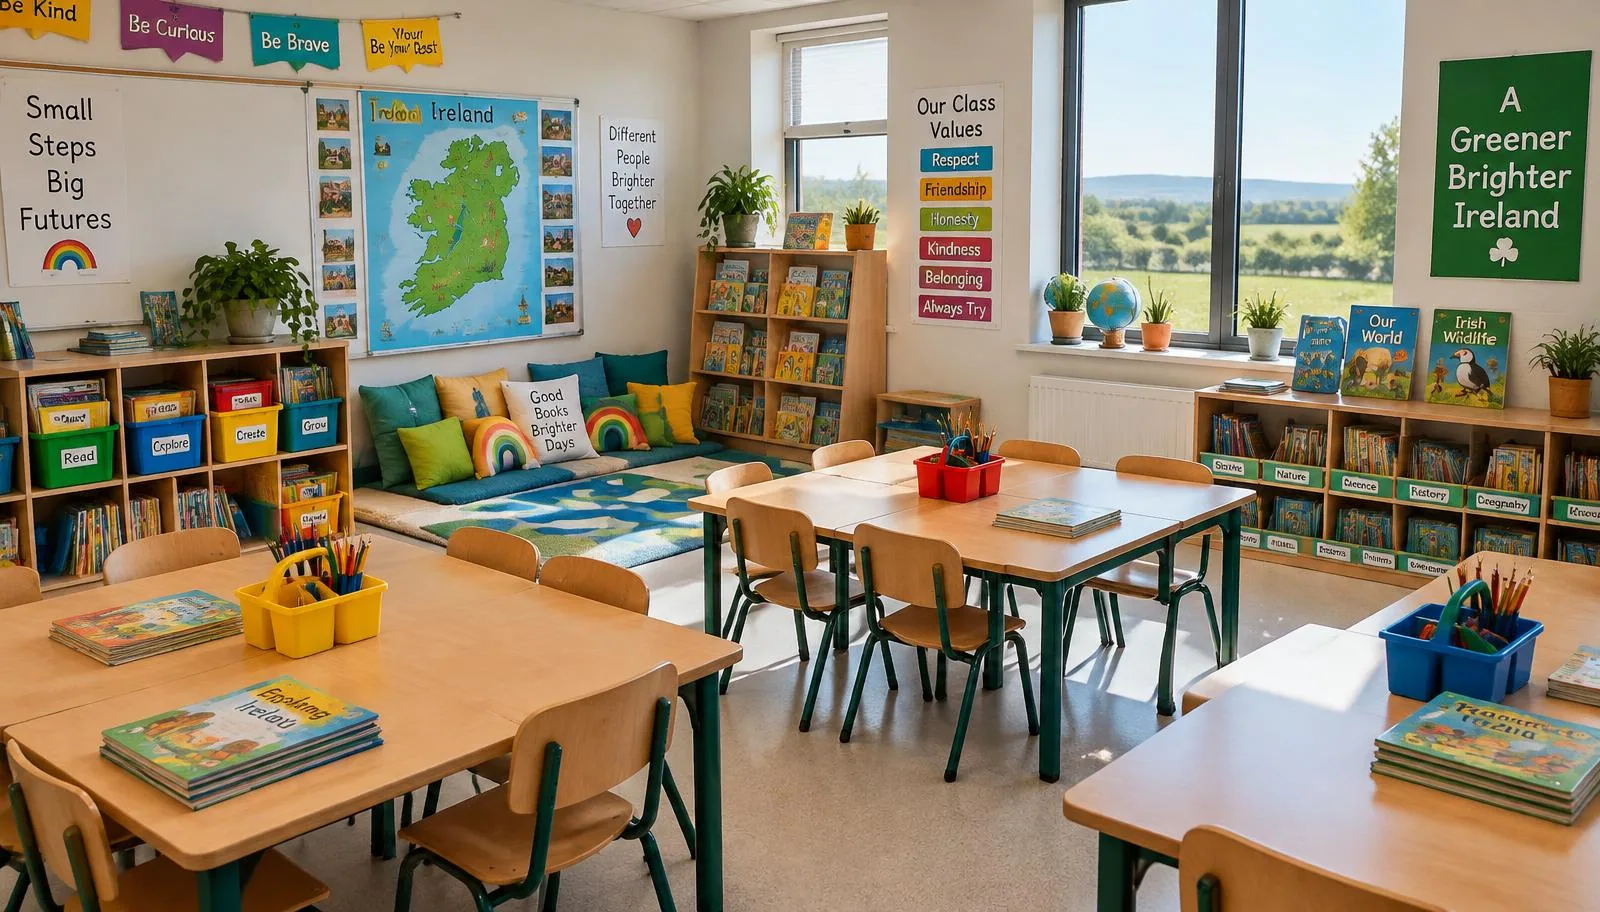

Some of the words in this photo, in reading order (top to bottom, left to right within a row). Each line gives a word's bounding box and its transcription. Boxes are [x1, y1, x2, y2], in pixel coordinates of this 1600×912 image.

[34, 0, 77, 21] Kind
[129, 14, 150, 33] Be
[261, 32, 281, 49] Be
[287, 33, 330, 52] Brave
[370, 38, 385, 54] Be
[26, 94, 93, 121] Small
[917, 97, 947, 116] Our
[952, 94, 996, 113] Class
[1499, 86, 1522, 113] A
[431, 101, 494, 123] Ireland
[609, 125, 657, 143] Different
[930, 121, 983, 139] Values
[1450, 126, 1572, 153] Greener
[28, 132, 96, 164] Steps
[616, 149, 650, 169] People
[932, 152, 980, 169] Respect
[47, 169, 84, 201] Big
[611, 171, 655, 191] Brighter
[1448, 161, 1572, 197] Brighter
[925, 182, 987, 200] Friendship
[608, 194, 656, 215] Together
[19, 207, 112, 231] Futures
[930, 212, 979, 230] Honesty
[1453, 201, 1560, 229] Ireland
[927, 240, 981, 257] Kindness
[925, 270, 983, 290] Belonging
[923, 299, 963, 317] Always
[966, 301, 987, 319] Try
[1369, 314, 1396, 328] Our
[1455, 315, 1487, 330] Irish
[1361, 329, 1403, 345] World
[530, 389, 564, 404] Good
[535, 406, 569, 420] Books
[531, 422, 577, 438] Brighter
[545, 438, 575, 452] Days
[64, 450, 95, 465] Read
[1276, 469, 1308, 482] Nature
